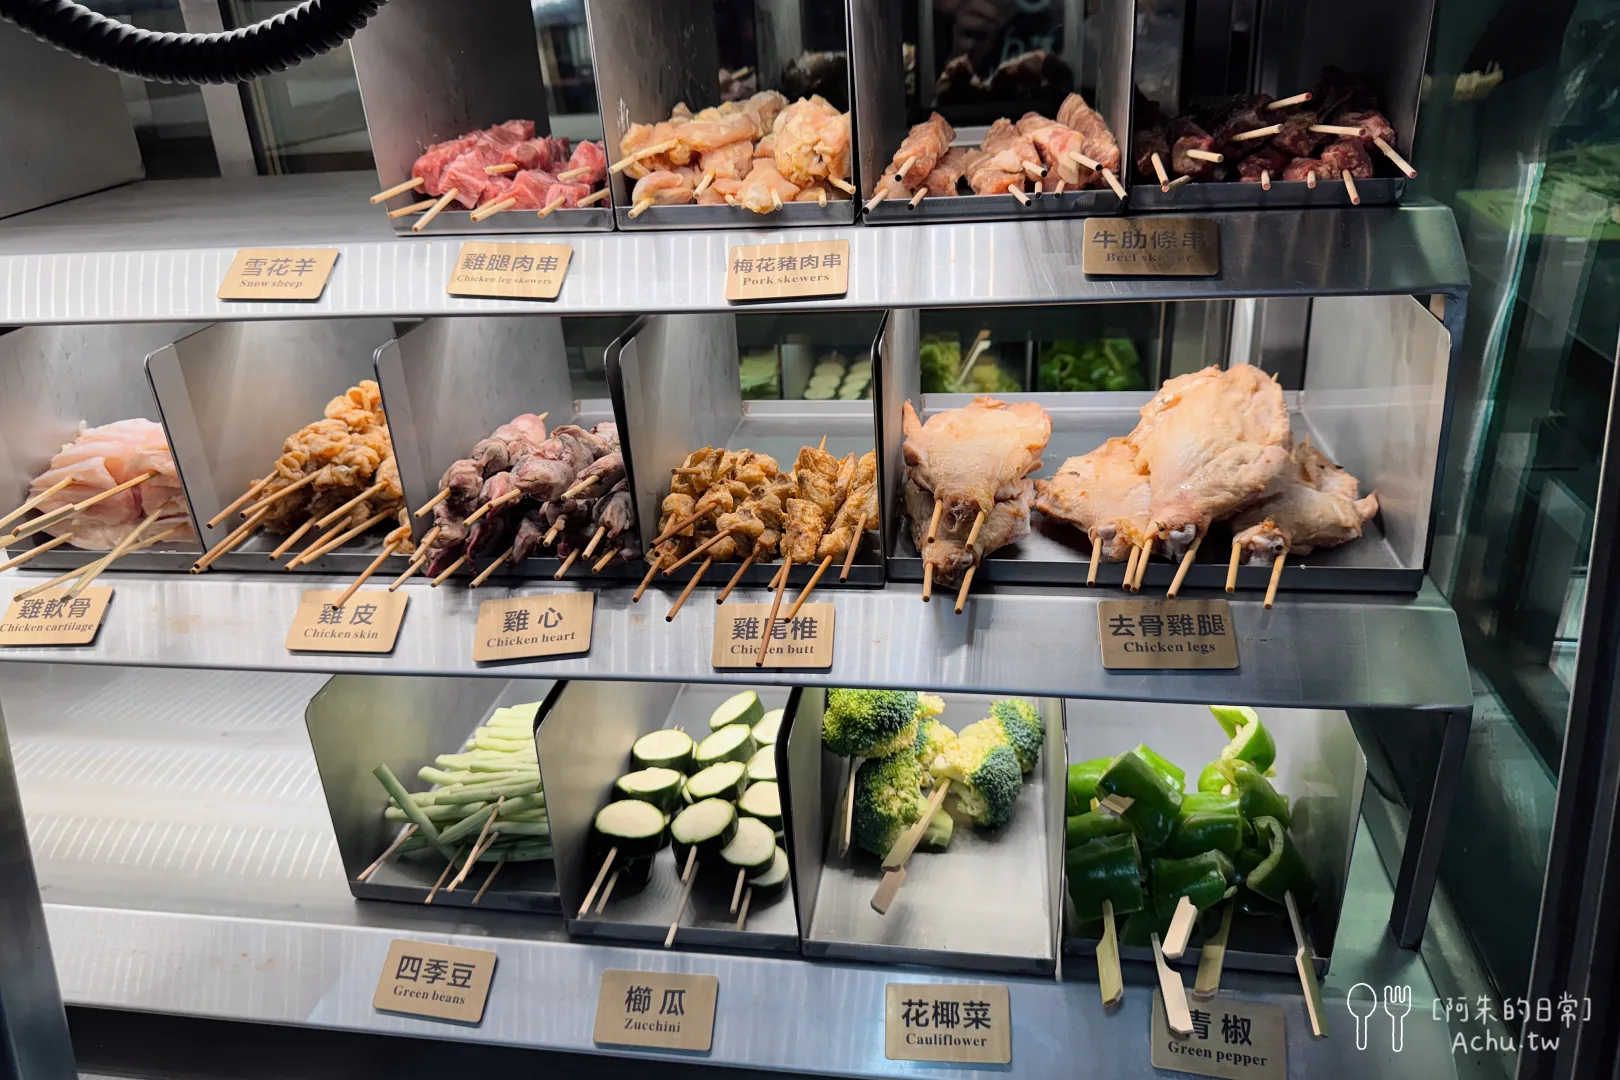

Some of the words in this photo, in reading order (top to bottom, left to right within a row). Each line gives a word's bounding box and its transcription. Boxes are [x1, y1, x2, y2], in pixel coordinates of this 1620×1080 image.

[1092, 229, 1207, 249] 牛肋條串
[240, 257, 317, 277] 雪花羊
[460, 253, 559, 273] 雞腿肉串
[733, 253, 842, 274] 梅花豬肉串
[1106, 252, 1138, 262] Beef
[239, 280, 269, 288] Snow
[271, 280, 303, 289] sheep
[457, 275, 496, 283] Chicken
[498, 276, 512, 285] leg
[514, 277, 552, 285] skewers
[742, 276, 774, 286] Pork
[777, 274, 830, 284] skewers
[17, 598, 92, 619] 雞軟骨
[317, 603, 378, 626] 雞皮
[0, 623, 44, 632] Chicken
[46, 622, 94, 632] cartilage
[503, 607, 564, 632] 雞心
[1109, 613, 1226, 637] 去骨雞腿
[303, 628, 351, 639] Chicken
[353, 629, 379, 640] skin
[486, 636, 538, 648] Chicken
[541, 632, 576, 643] heart
[730, 645, 784, 655] Chicen
[787, 645, 815, 655] butt
[1123, 641, 1184, 653] Chicken
[1187, 641, 1216, 654] legs
[395, 955, 476, 989] 四季豆
[393, 984, 429, 999] Green
[431, 990, 467, 1005] beans
[624, 985, 687, 1016] 櫛瓜
[901, 999, 992, 1030] 花椰菜
[624, 1018, 681, 1033] Zucchini
[905, 1032, 988, 1047] Cauliflower
[1167, 1040, 1213, 1059] Green
[1216, 1050, 1268, 1067] pepper
